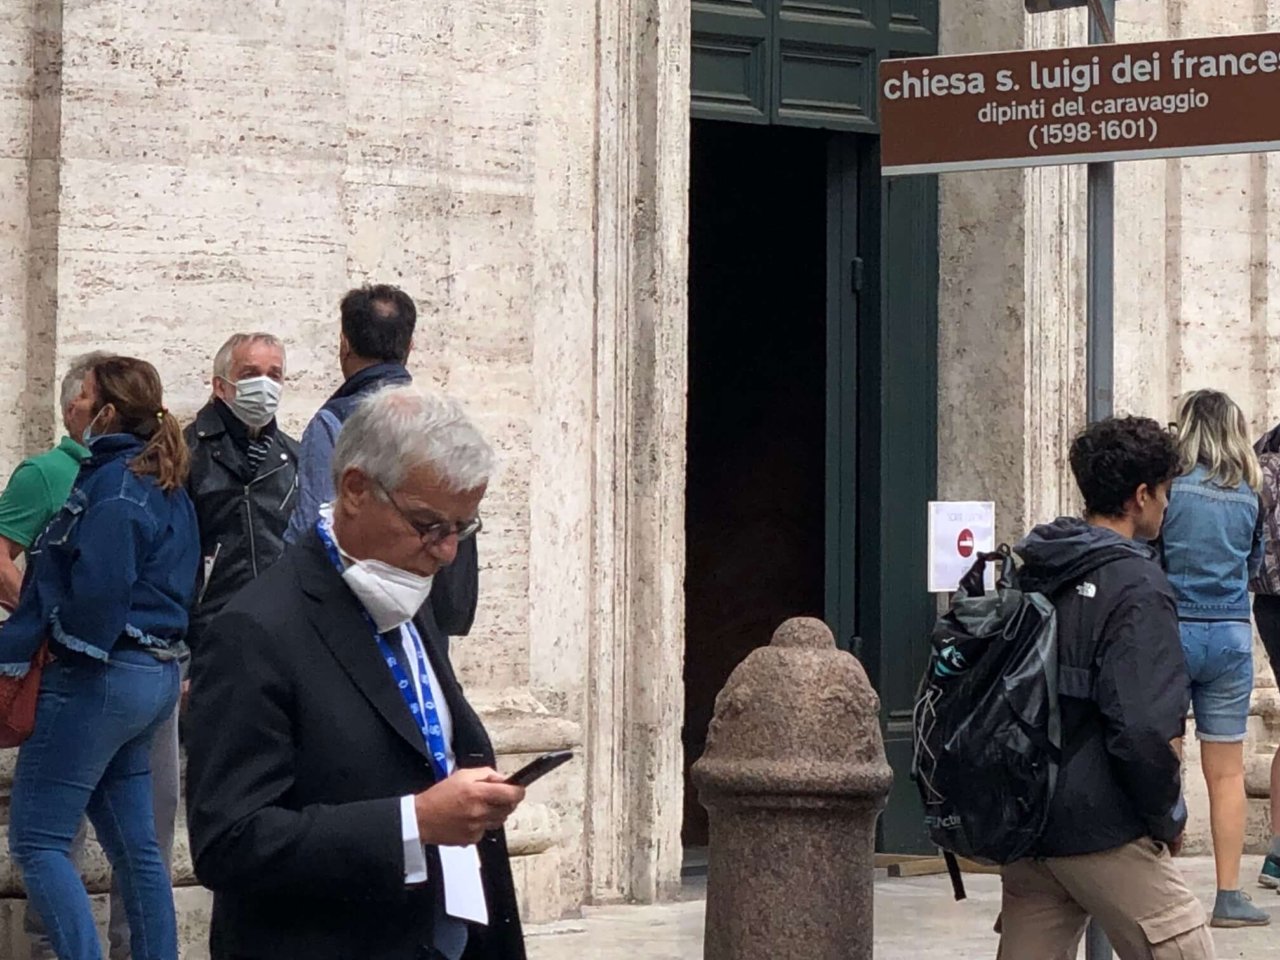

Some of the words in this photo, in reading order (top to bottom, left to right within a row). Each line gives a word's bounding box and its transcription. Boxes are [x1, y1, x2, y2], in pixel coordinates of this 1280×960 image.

[884, 68, 985, 100] chiesa
[996, 70, 1020, 91] s.
[1031, 56, 1100, 93] luigi
[1112, 52, 1160, 84] dei
[978, 99, 1045, 125] dipinti
[1052, 96, 1085, 118] del
[1091, 88, 1209, 114] caravaggio
[1029, 117, 1158, 150] (1598-1601)
